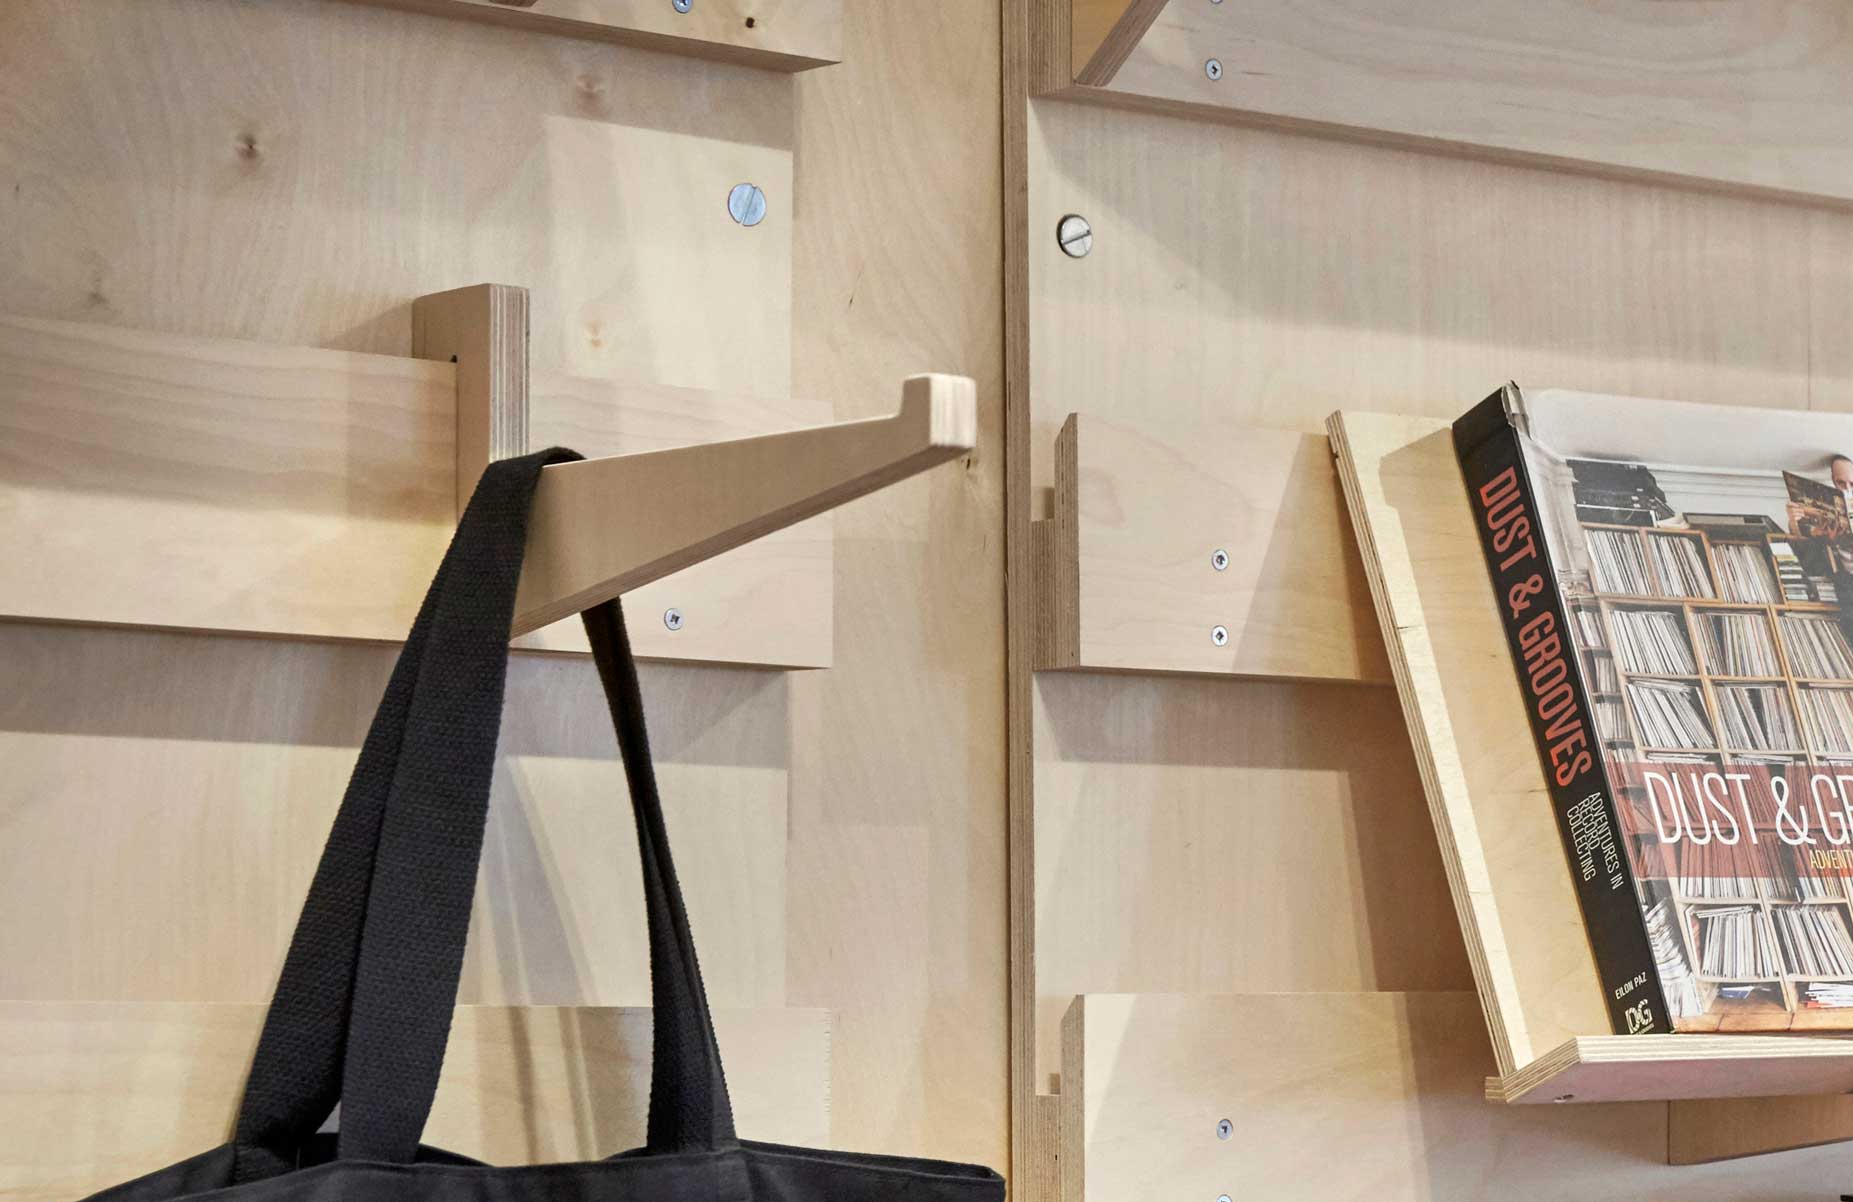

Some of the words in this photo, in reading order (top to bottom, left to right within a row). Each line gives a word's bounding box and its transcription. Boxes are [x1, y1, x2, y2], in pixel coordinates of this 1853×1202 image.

[1480, 466, 1536, 572] DUST
[1508, 574, 1543, 619] &
[1519, 611, 1591, 787] GROOVES
[1567, 806, 1596, 882] COLLECTING
[1578, 797, 1600, 851] RECORD
[1589, 791, 1620, 874] ADVENTURES
[1611, 874, 1624, 890] IN
[1643, 771, 1758, 845] DUST
[1771, 776, 1816, 845] &
[1615, 980, 1634, 1000] EILON
[1634, 971, 1647, 989] PAZ
